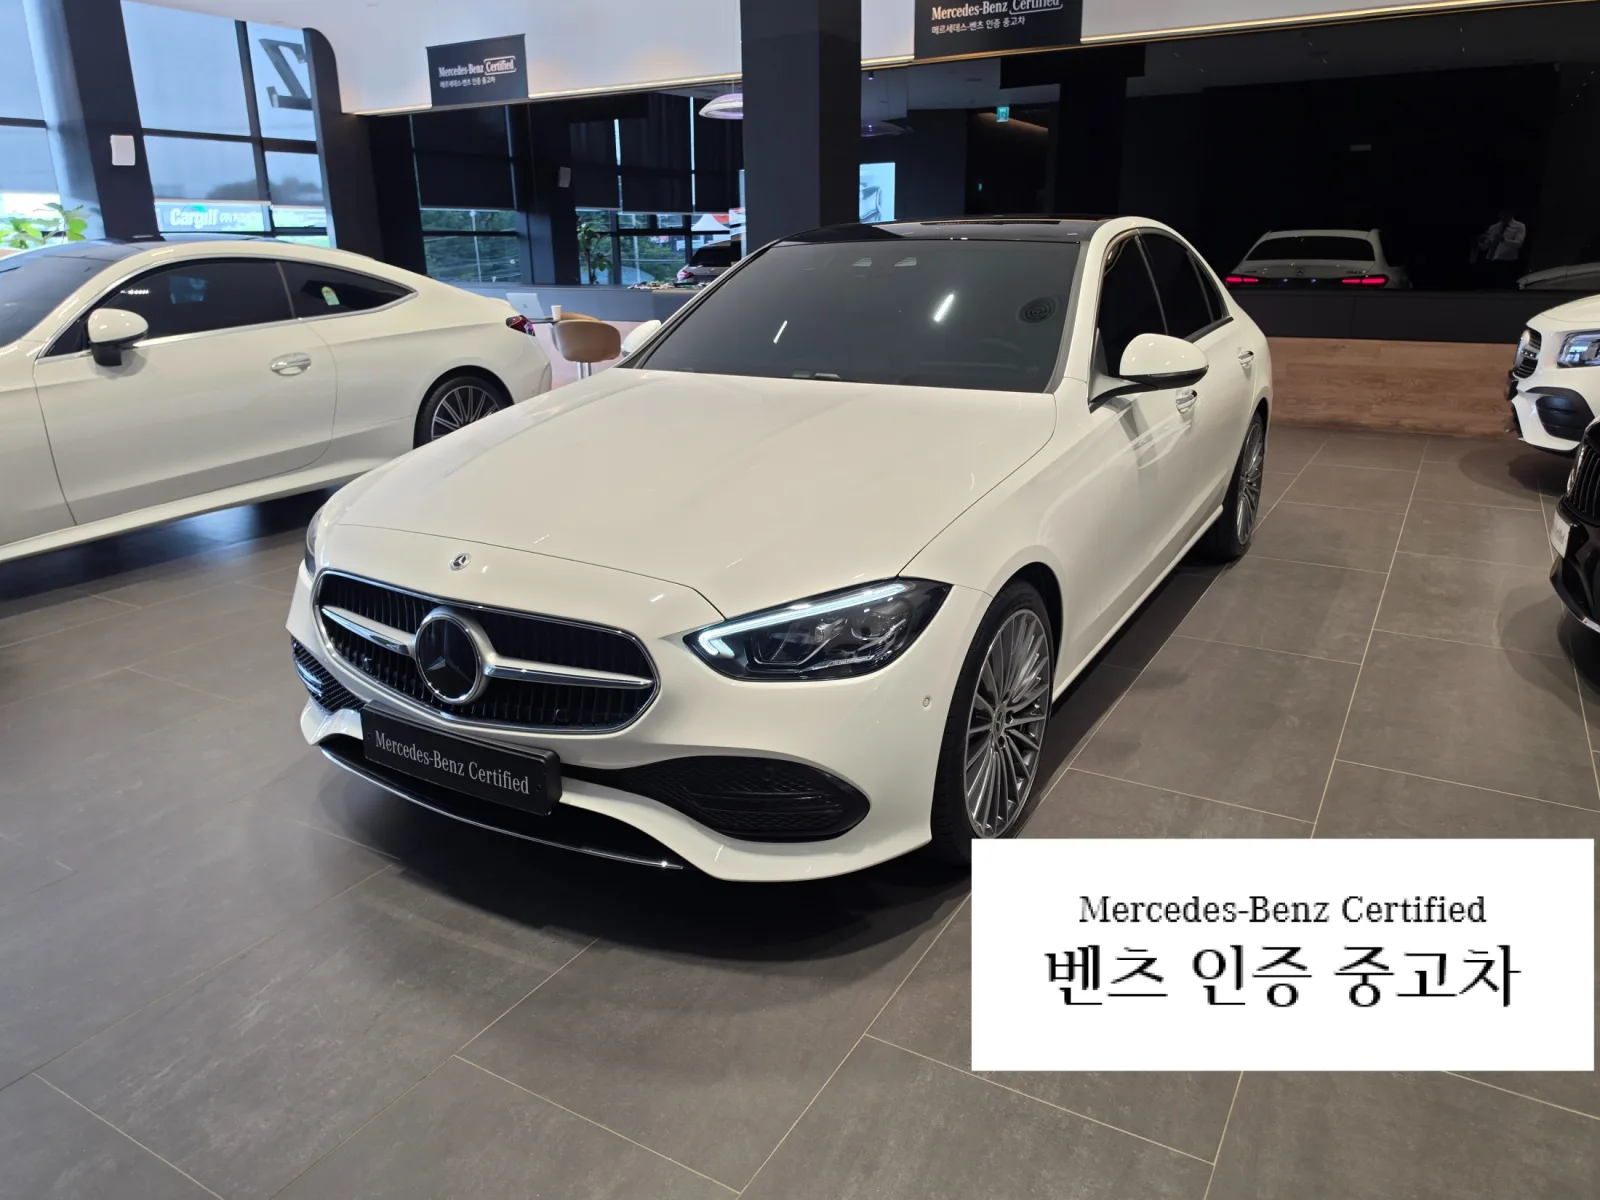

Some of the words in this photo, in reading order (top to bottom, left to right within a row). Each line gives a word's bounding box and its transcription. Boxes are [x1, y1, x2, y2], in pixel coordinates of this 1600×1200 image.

[931, 1, 1008, 20] Mercedes-Benz
[931, 20, 984, 35] 메르세데스-벤츠
[985, 18, 1001, 30] 인증
[1002, 15, 1026, 28] 중고차
[438, 63, 484, 77] Mercedes-Benz
[486, 59, 514, 72] Certified
[170, 207, 218, 229] Cargill
[374, 730, 465, 777] Mercedes-Benz
[468, 761, 530, 795] Certified
